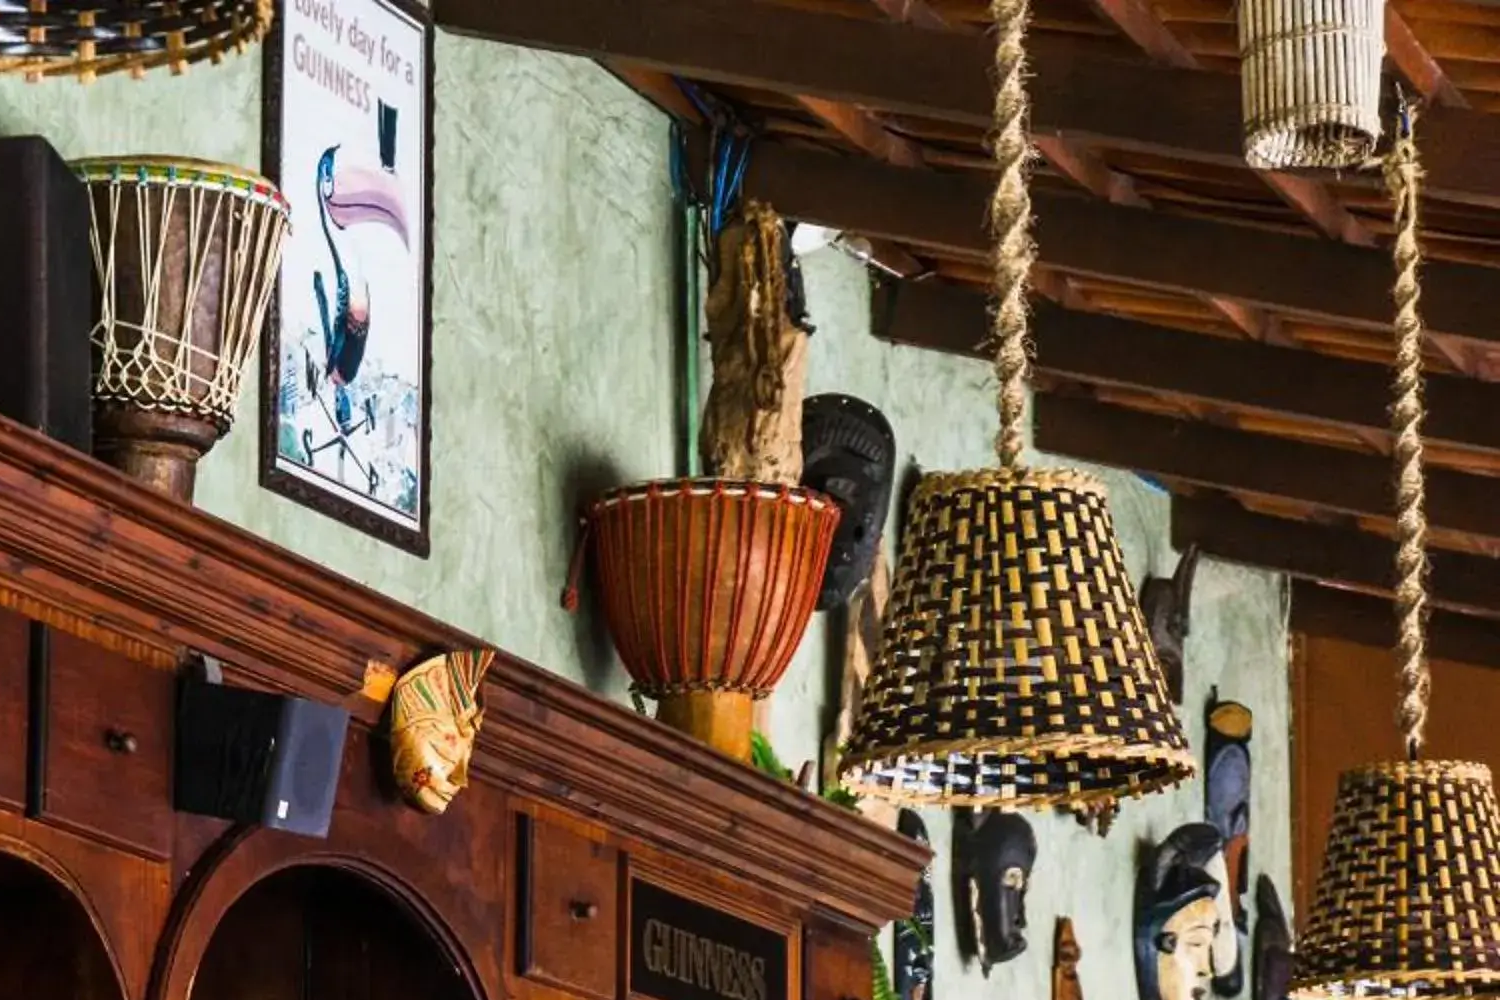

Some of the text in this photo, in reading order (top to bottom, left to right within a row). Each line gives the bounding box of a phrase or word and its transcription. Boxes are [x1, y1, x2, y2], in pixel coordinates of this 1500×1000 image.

[293, 33, 371, 114] GUINNESS
[348, 17, 375, 65] day
[380, 36, 402, 77] for
[405, 61, 414, 86] a
